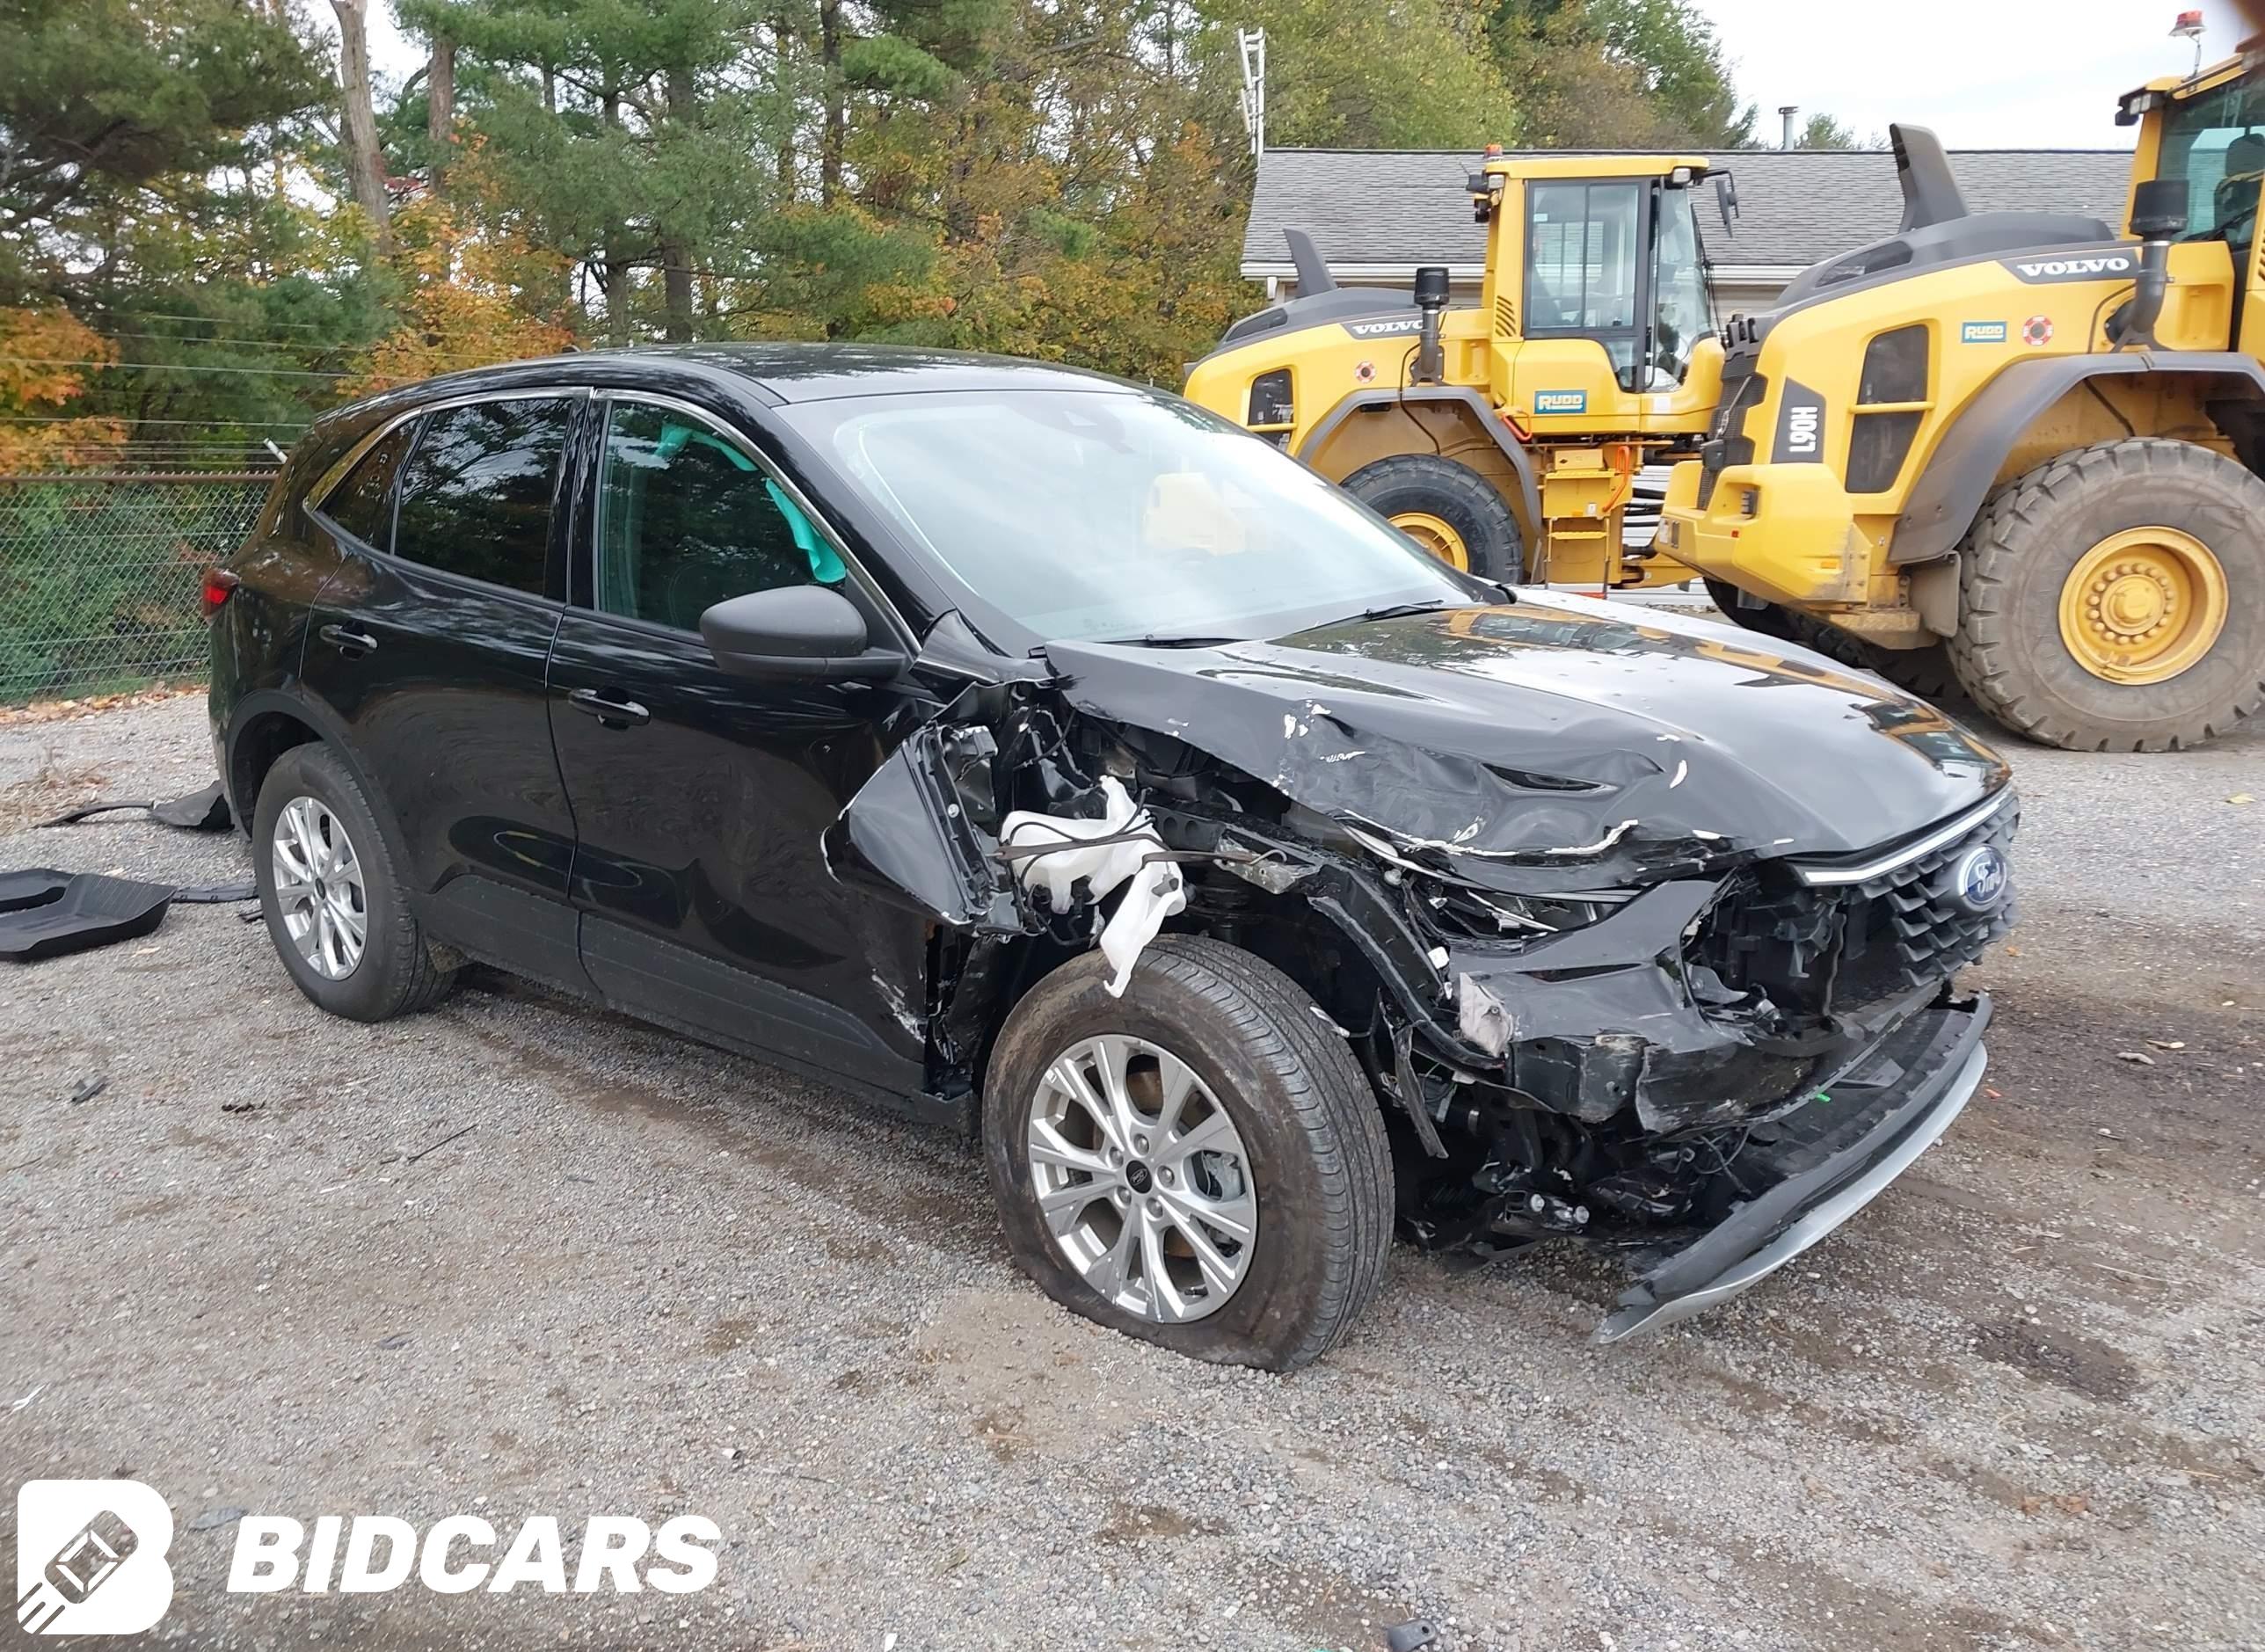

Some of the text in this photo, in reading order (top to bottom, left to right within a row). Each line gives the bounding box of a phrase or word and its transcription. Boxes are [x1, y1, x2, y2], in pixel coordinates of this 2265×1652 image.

[2017, 258, 2130, 276] VOLVO
[1964, 325, 2004, 339] RUDD
[1539, 395, 1583, 410] RUDD
[1789, 406, 1817, 452] L90H
